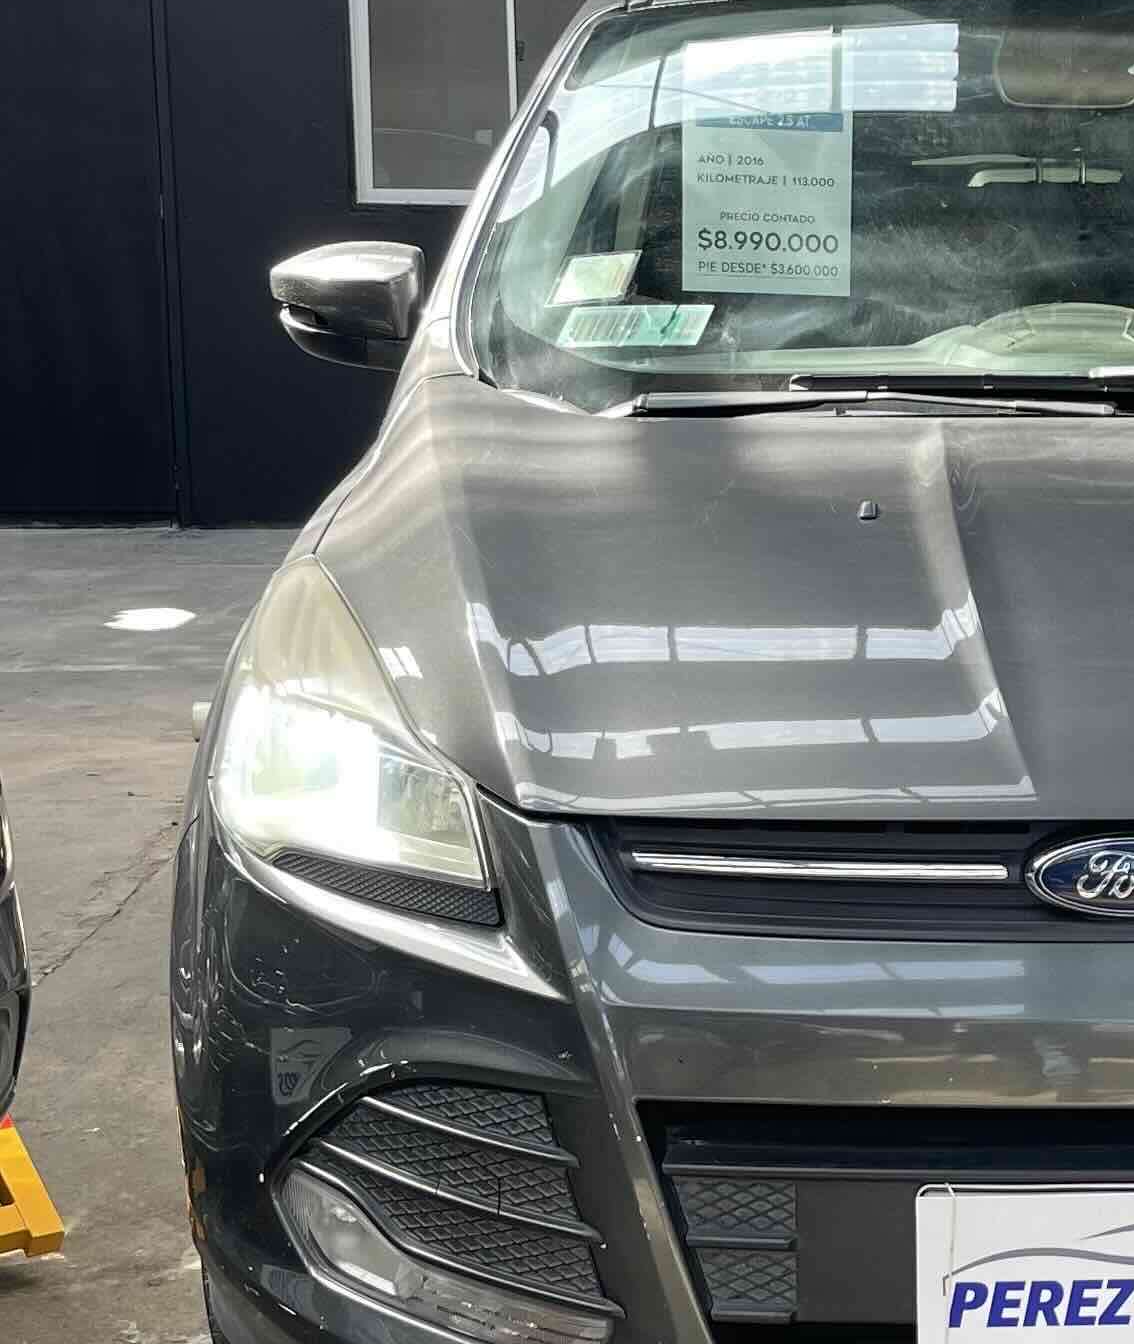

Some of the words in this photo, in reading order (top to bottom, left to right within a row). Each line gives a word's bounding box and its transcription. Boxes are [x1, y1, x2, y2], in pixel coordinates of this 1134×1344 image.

[698, 153, 725, 165] AÑO
[737, 156, 765, 166] 2016
[697, 173, 778, 185] KILOMETRAJE
[720, 211, 760, 222] PRECIO
[763, 213, 815, 224] CONTADO
[698, 227, 839, 253] $8.990.000
[698, 260, 718, 272] PIE
